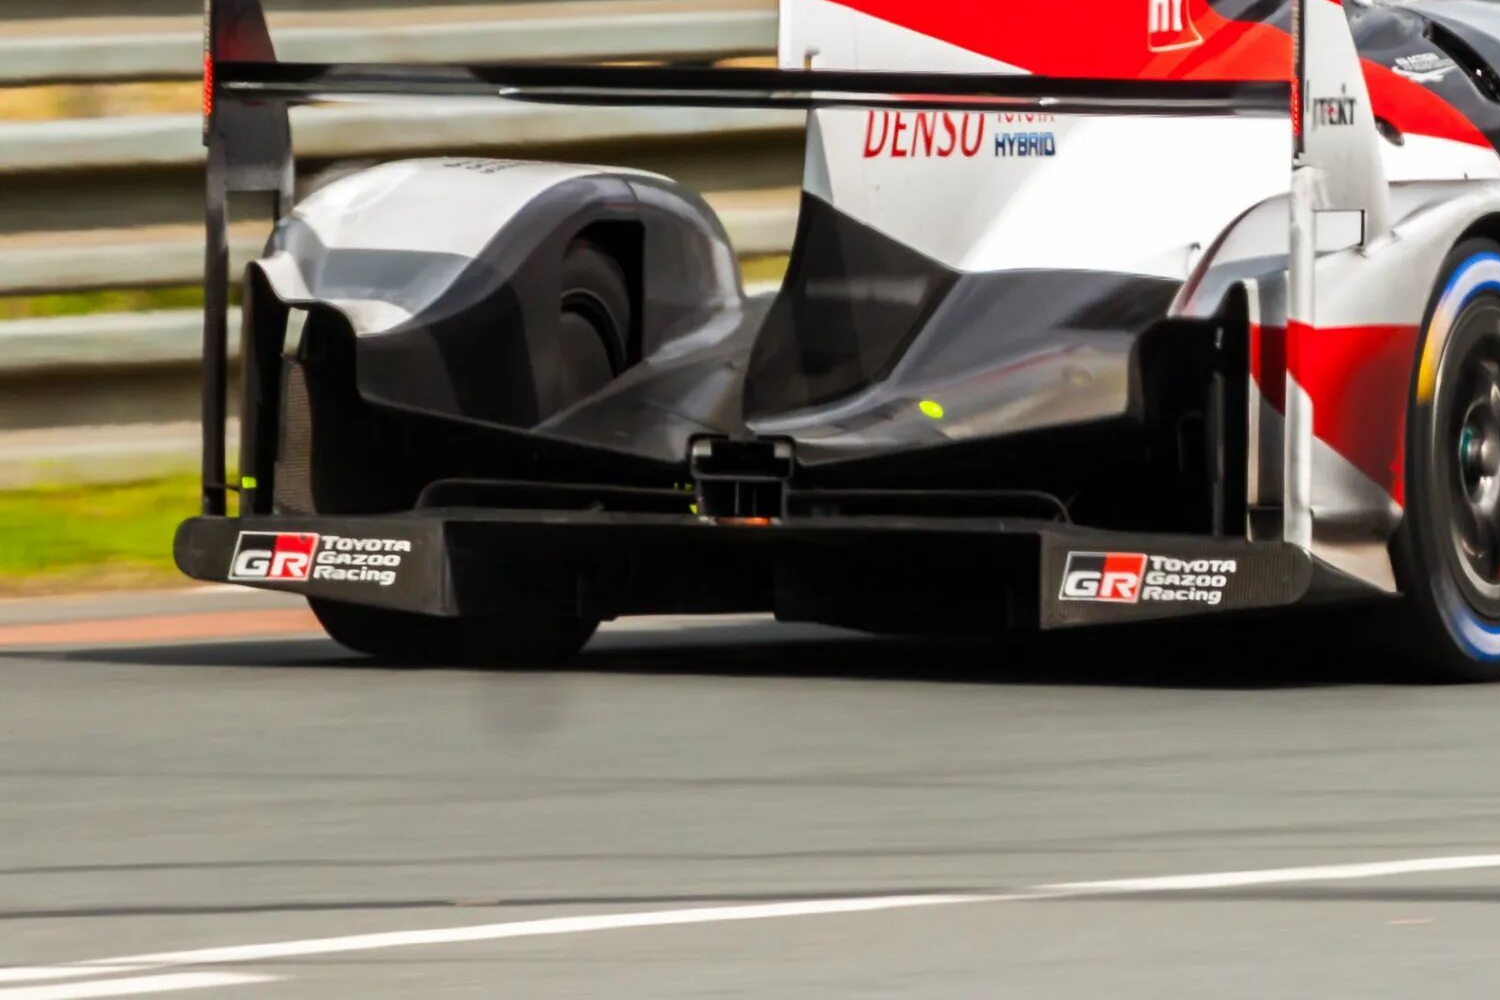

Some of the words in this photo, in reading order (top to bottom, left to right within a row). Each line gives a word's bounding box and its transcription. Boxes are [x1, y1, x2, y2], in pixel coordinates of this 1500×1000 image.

[994, 132, 1056, 156] HYBRID
[321, 535, 411, 552] TOYOTA
[234, 549, 309, 577] GR
[316, 550, 401, 567] GAZOO
[1150, 555, 1237, 573] TOYOTA
[312, 565, 396, 586] Racing
[1064, 570, 1138, 598] GR
[1145, 572, 1227, 588] GAZOO
[1141, 586, 1222, 605] Racing
